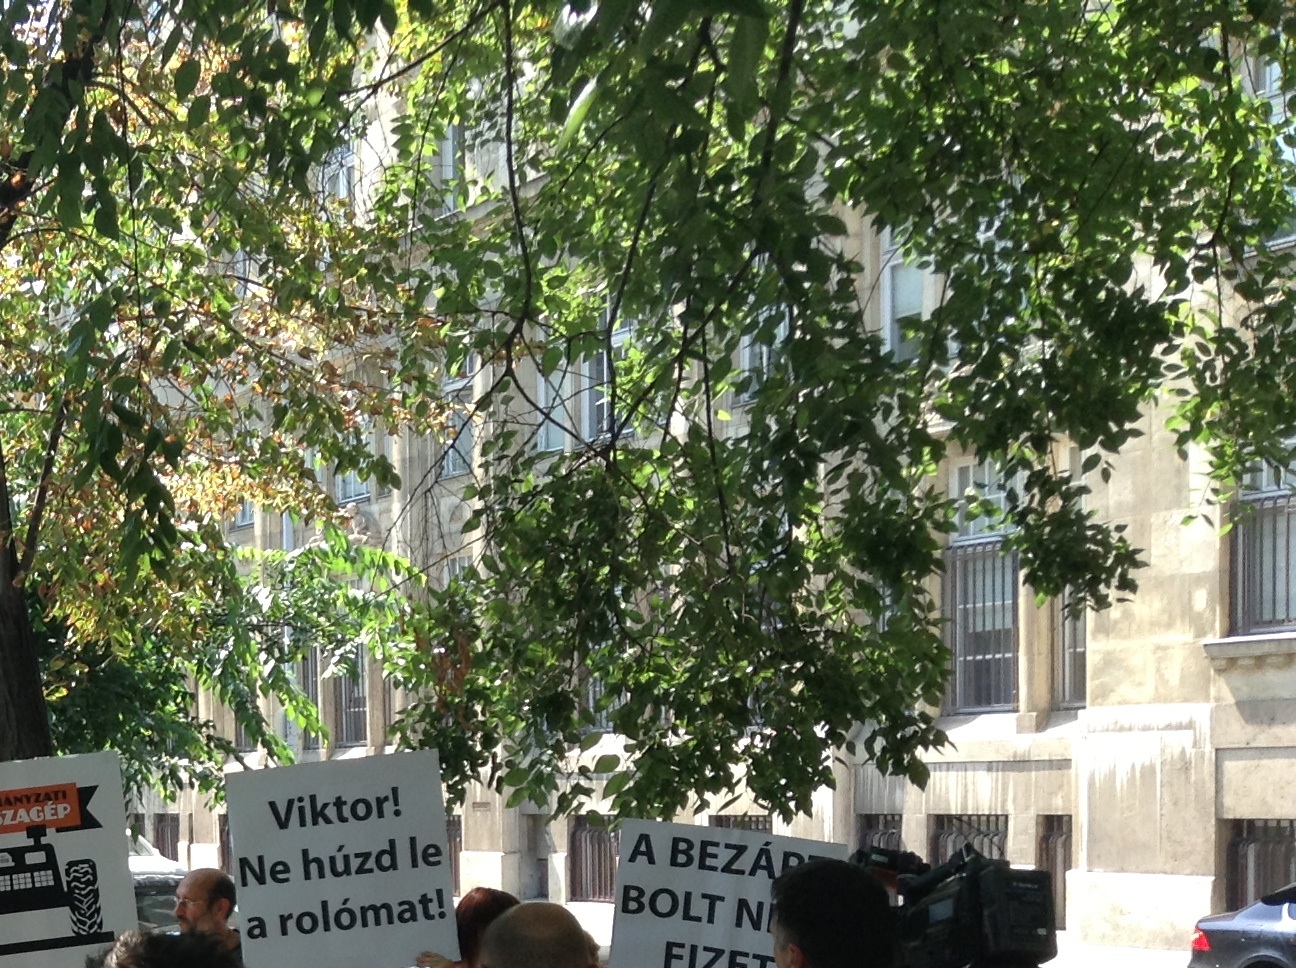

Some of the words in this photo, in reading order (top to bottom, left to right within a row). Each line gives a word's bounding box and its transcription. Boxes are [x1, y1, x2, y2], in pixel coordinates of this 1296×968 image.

[268, 786, 402, 831] Viktor!
[238, 855, 291, 888] Ne
[301, 838, 399, 881] húzd
[409, 836, 443, 869] le
[628, 833, 656, 866] A
[246, 915, 268, 940] a
[279, 888, 447, 936] rolómat!
[621, 884, 725, 925] BOLT
